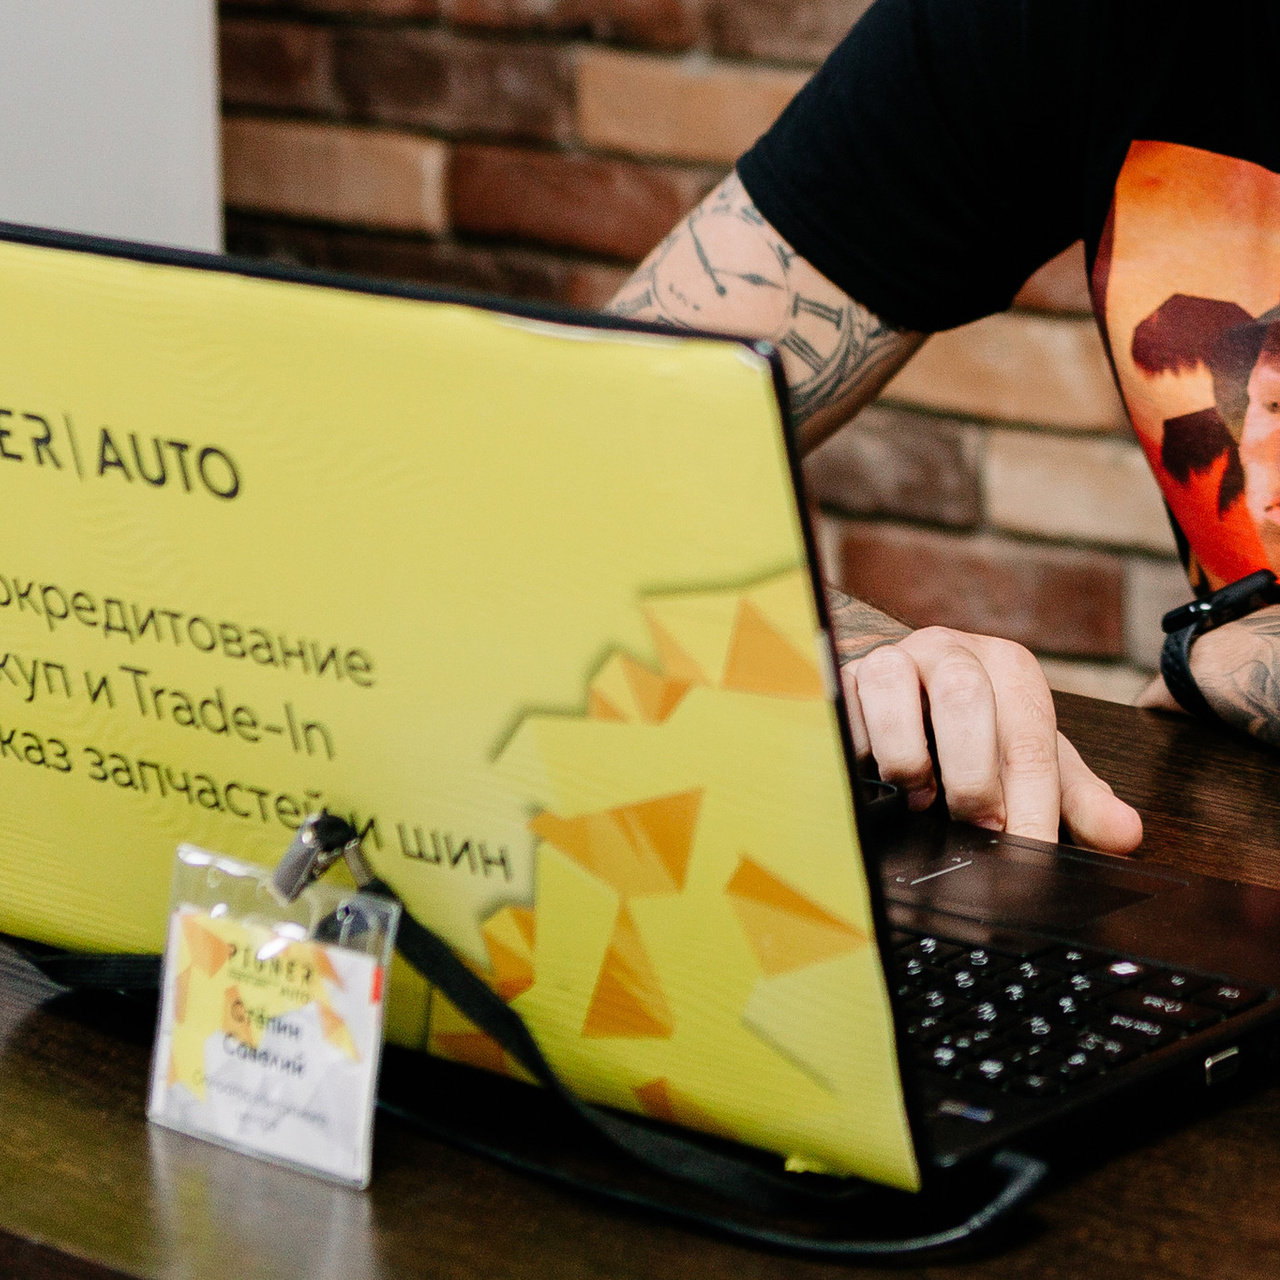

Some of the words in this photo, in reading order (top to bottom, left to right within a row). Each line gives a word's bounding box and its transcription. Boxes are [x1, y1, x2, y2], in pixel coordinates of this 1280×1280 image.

[97, 426, 240, 499] AUTO
[84, 670, 115, 710] и
[118, 665, 336, 761] Trade-In
[0, 728, 72, 774] каз
[396, 821, 514, 883] шин
